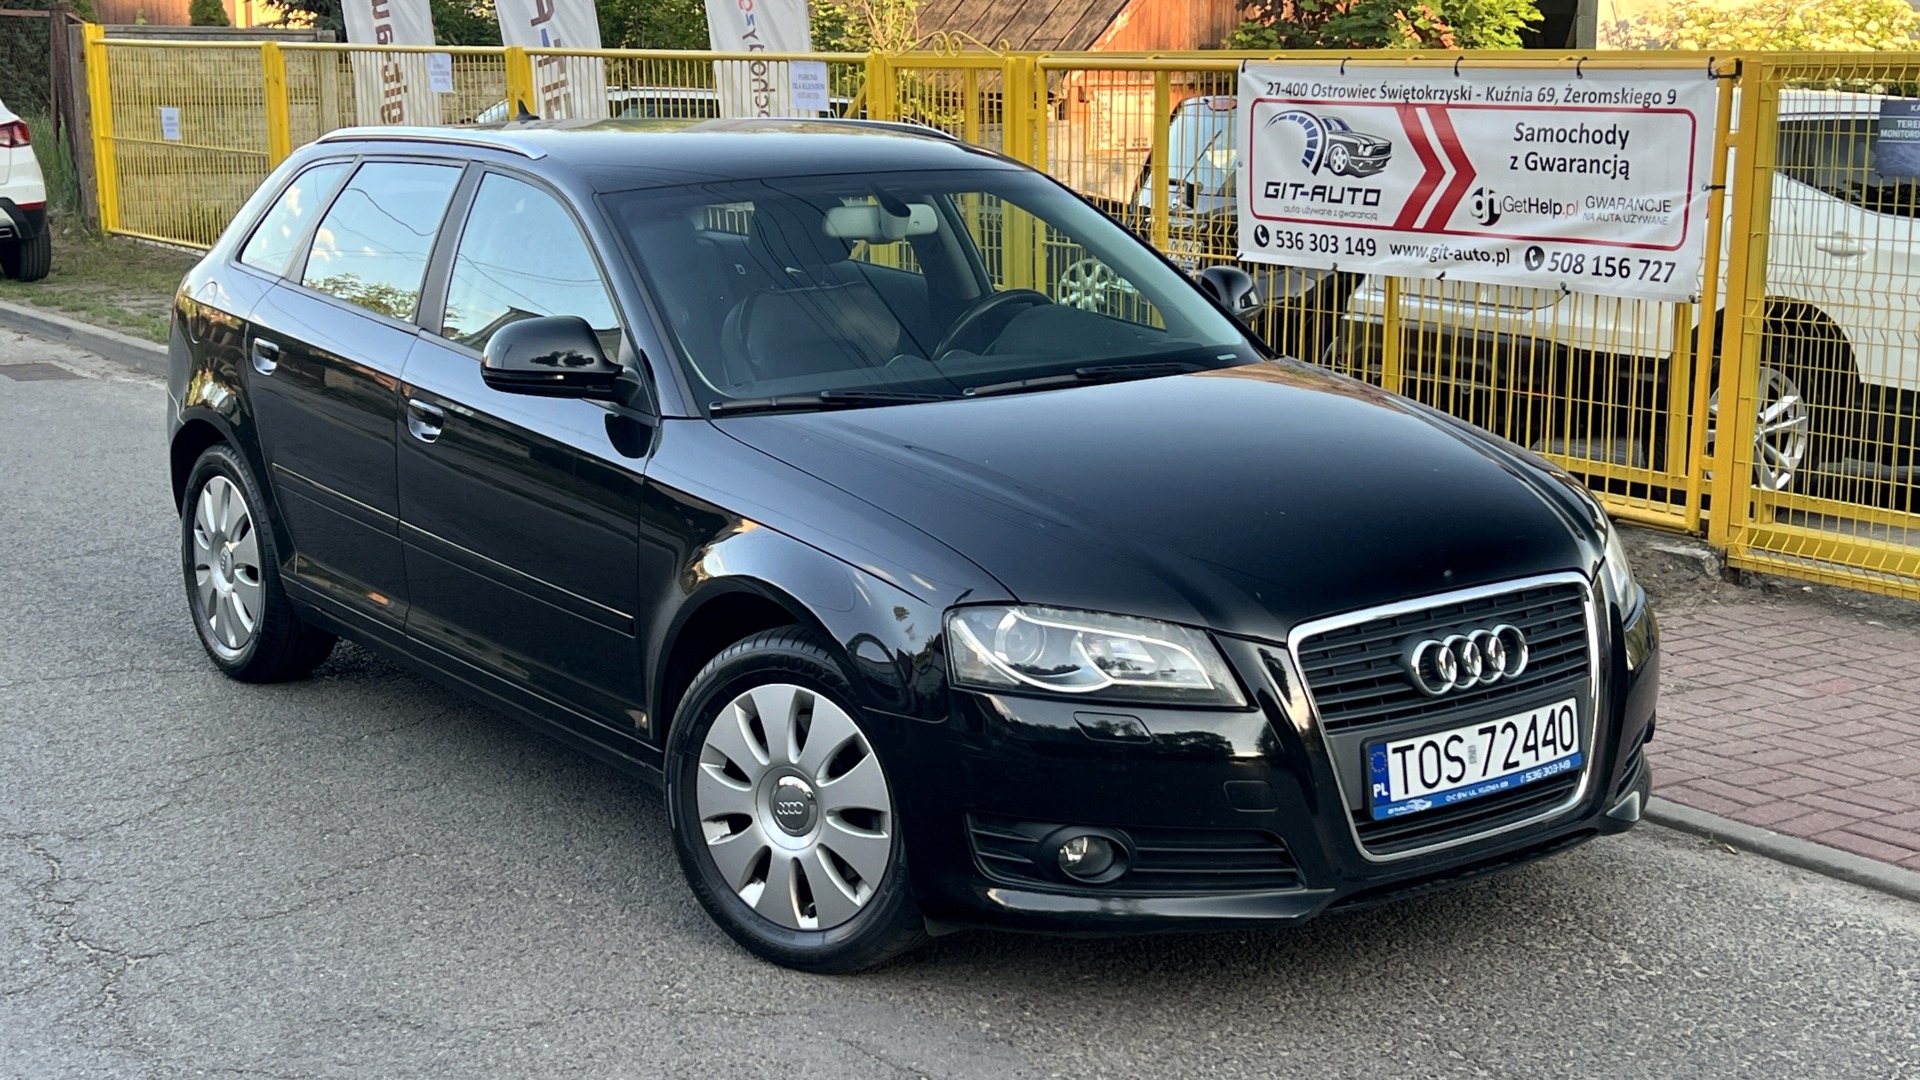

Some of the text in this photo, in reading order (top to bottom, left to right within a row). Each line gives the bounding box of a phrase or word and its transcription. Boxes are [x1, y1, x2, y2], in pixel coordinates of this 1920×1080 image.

[1266, 81, 1307, 97] 27-400
[1311, 83, 1376, 100] Ostrowiec
[1379, 81, 1472, 105] Świętokrzyski
[1486, 86, 1533, 103] Kuźnia
[1537, 87, 1559, 106] 69,
[1563, 83, 1662, 108] Żeromskiego
[1666, 89, 1677, 105] 9
[1513, 122, 1630, 150] Samochody
[1896, 119, 1920, 128] TERE
[1510, 152, 1630, 180] z Gwarancją
[1264, 181, 1381, 207] GIT-AUTO
[1502, 195, 1579, 221] GetHelp.pl
[1585, 195, 1672, 213] GWARANCJE
[1582, 212, 1668, 225] NA AUTA UŻYWANE
[1276, 230, 1377, 257] 536 303 149
[1389, 242, 1510, 267] www.git-auto.pl
[1547, 251, 1676, 283] 508 156 727
[1391, 704, 1575, 795] TOS 72440
[1373, 782, 1389, 798] PL
